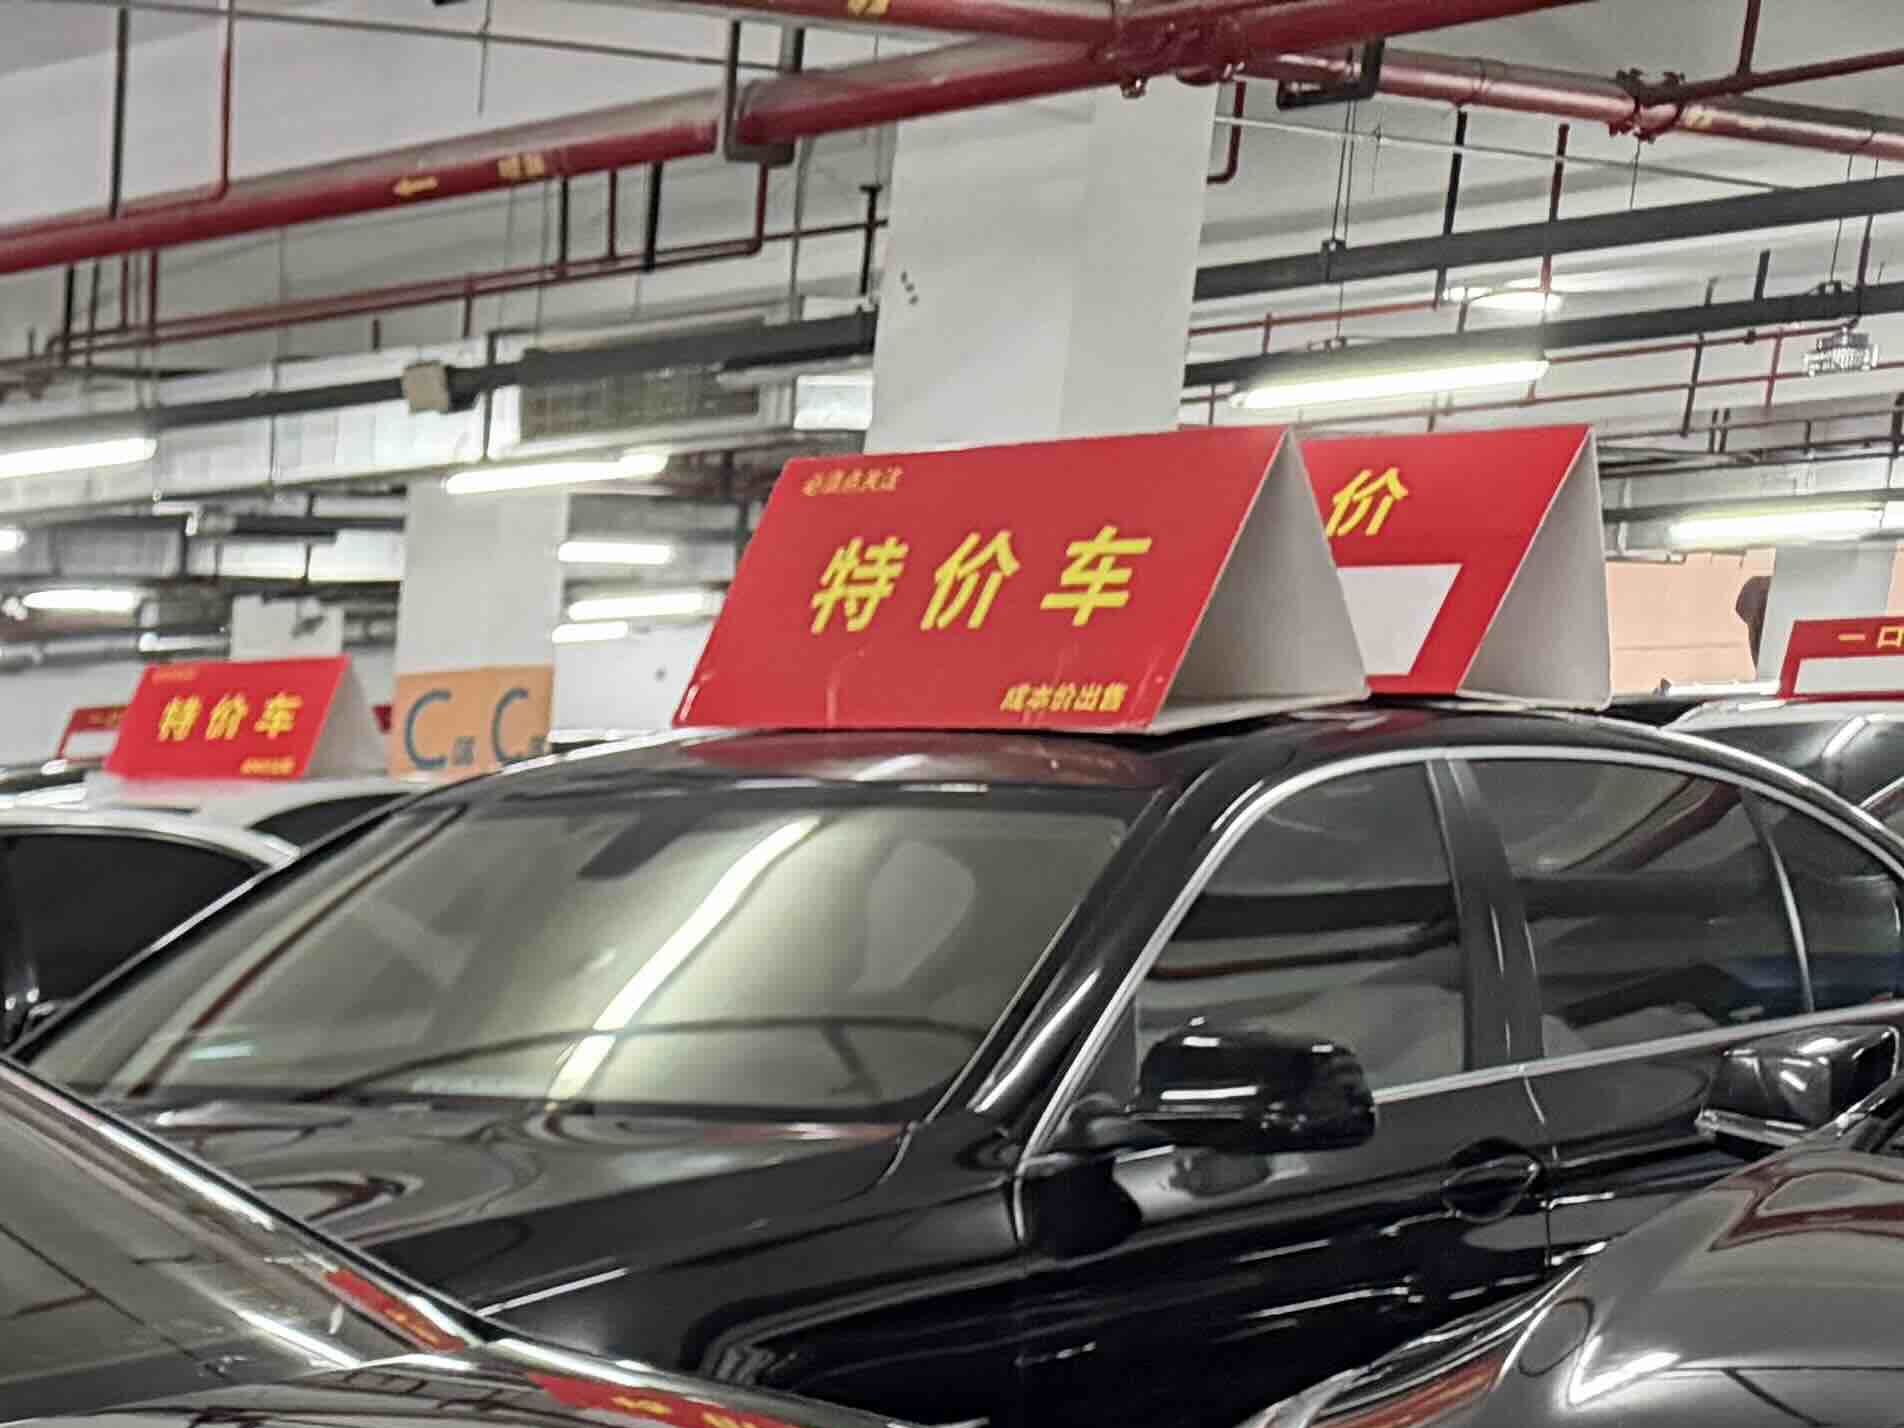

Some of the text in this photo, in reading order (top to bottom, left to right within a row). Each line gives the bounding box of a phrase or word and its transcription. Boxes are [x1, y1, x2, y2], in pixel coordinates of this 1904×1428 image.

[1325, 467, 1408, 536] 价
[809, 525, 1152, 634] 特价车
[157, 691, 304, 742] 特价车
